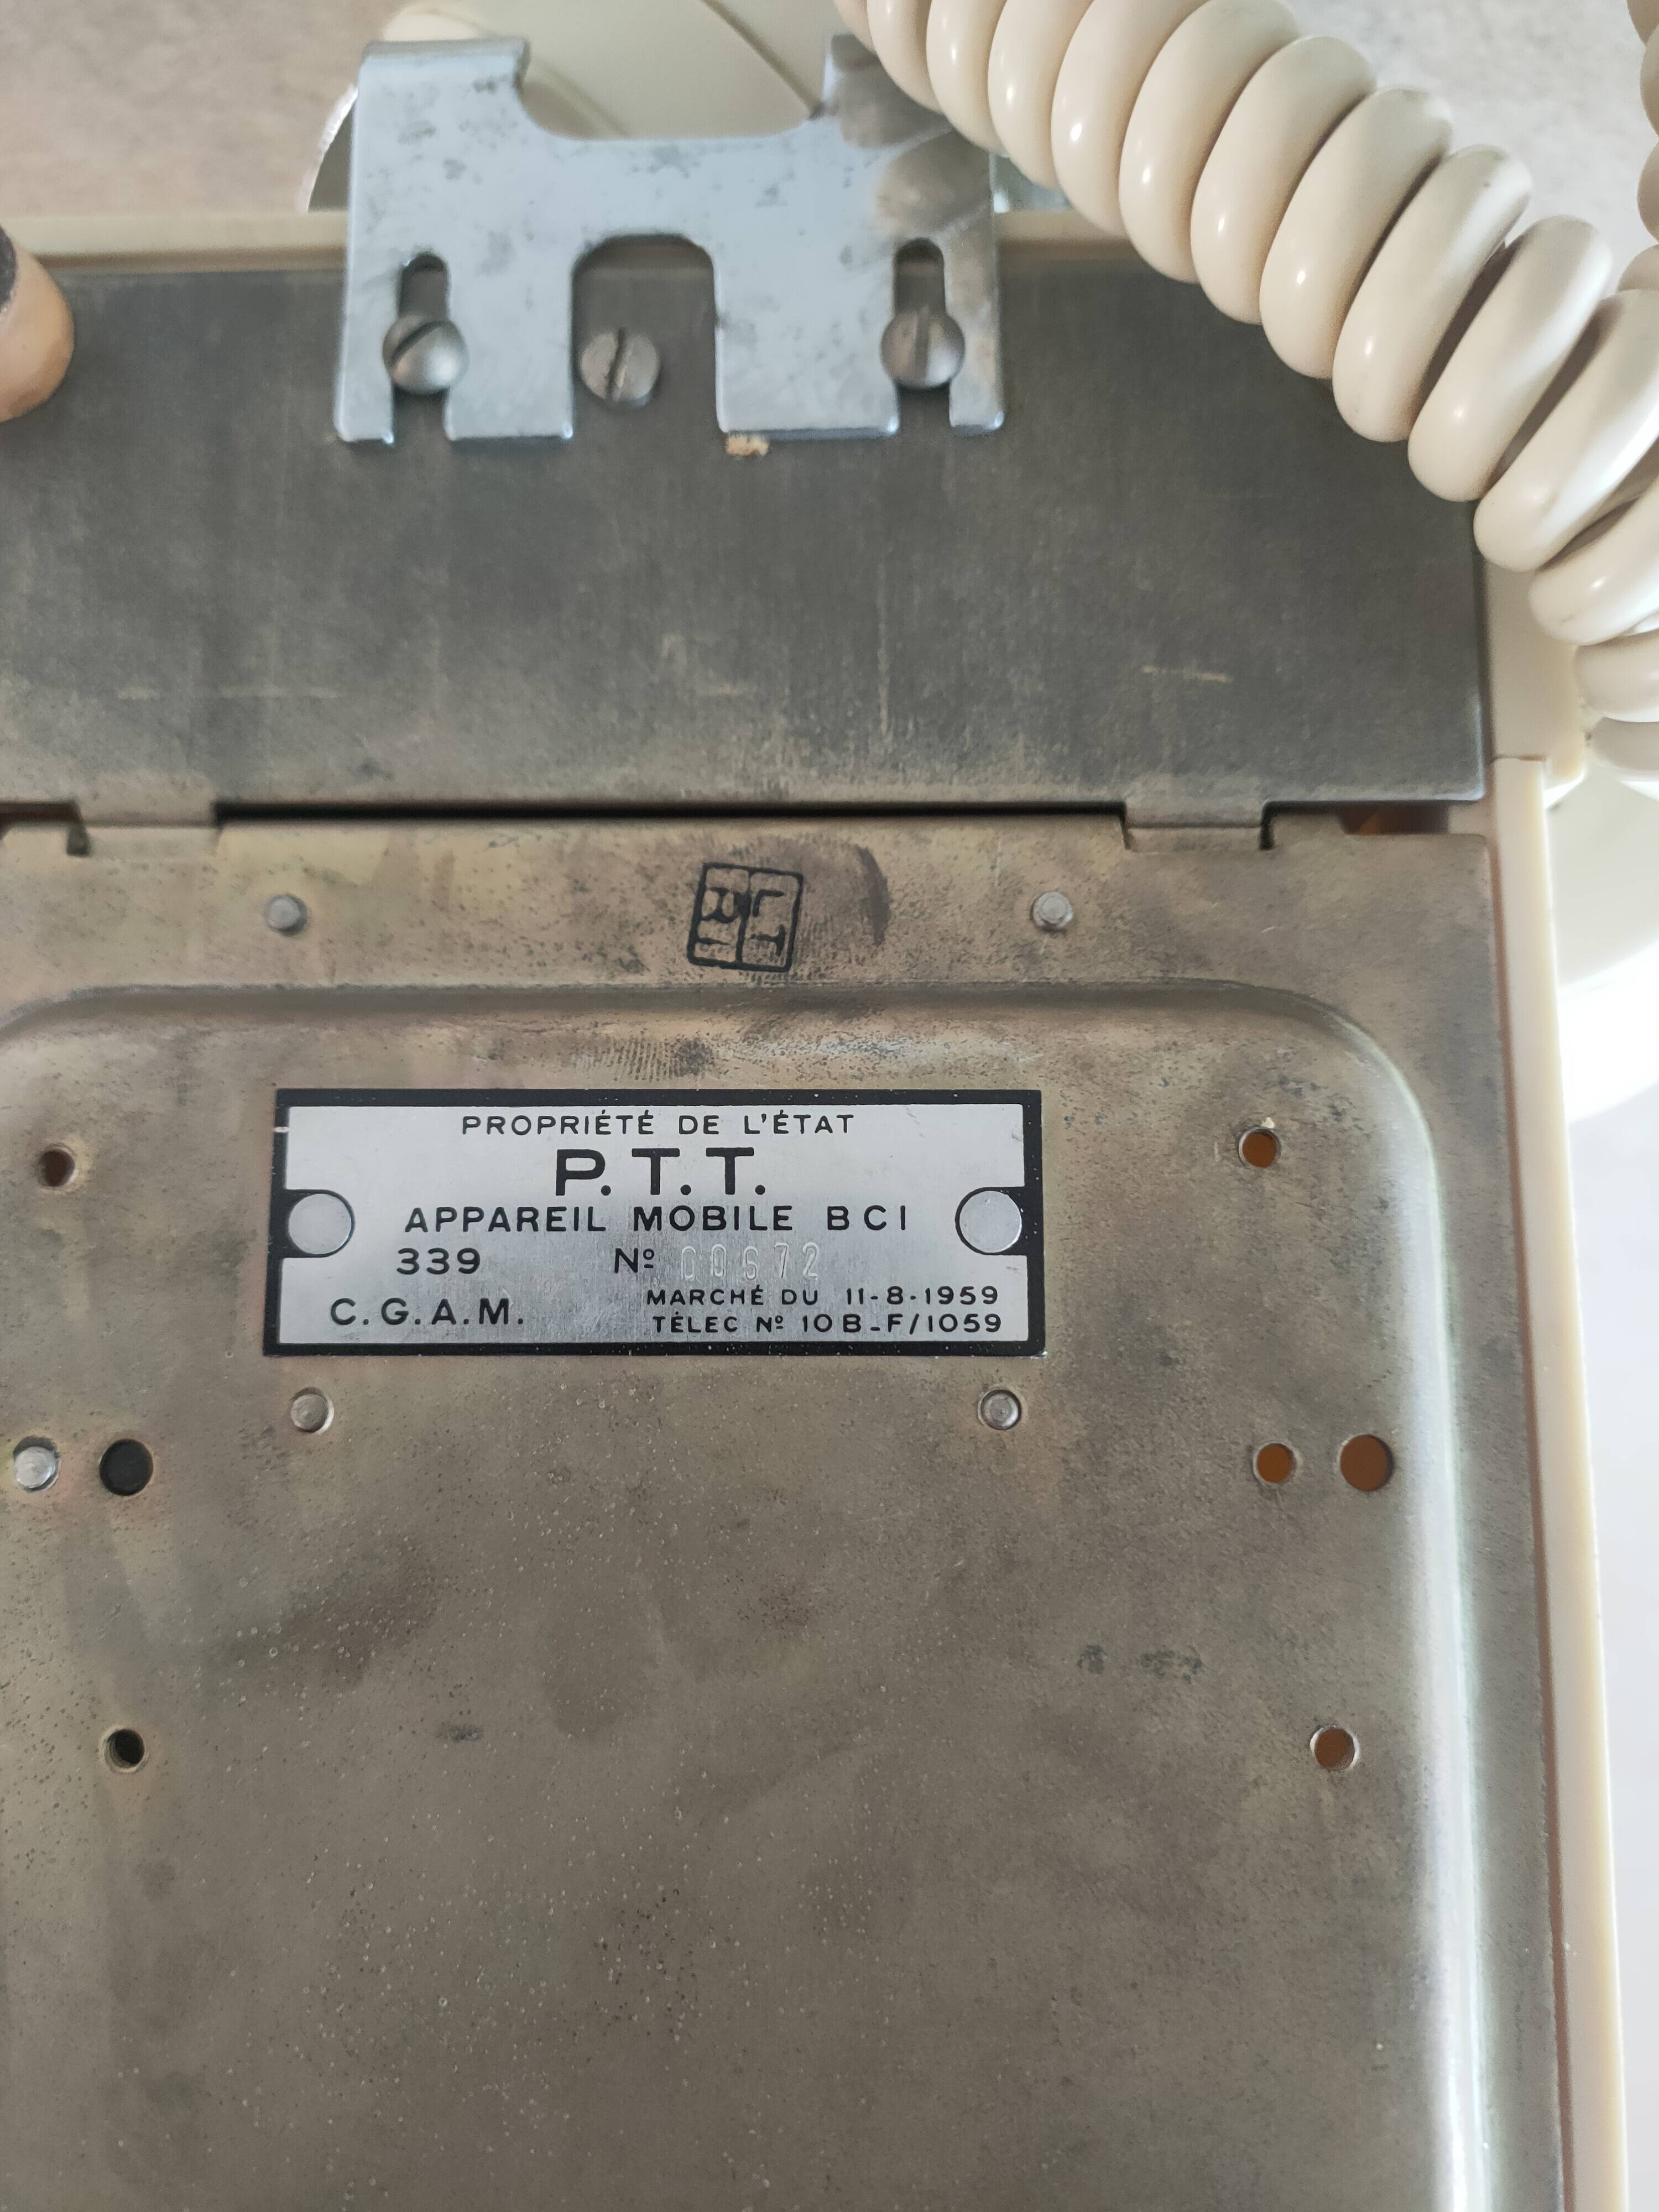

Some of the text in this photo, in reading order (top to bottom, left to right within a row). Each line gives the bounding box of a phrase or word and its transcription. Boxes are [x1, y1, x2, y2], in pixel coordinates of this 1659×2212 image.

[462, 1109, 854, 1135] PROPRIÉTÉ DE L'ÉTAT
[555, 1147, 766, 1196] P.T.T.
[405, 1206, 606, 1233] APPAREIL
[633, 1205, 792, 1232] MOBILE
[396, 1248, 481, 1275] 339
[646, 1284, 764, 1306] MARCHÉ
[781, 1289, 818, 1306] DU
[330, 1297, 524, 1326] C.G.A.M.
[652, 1311, 738, 1333] TÉLEC
